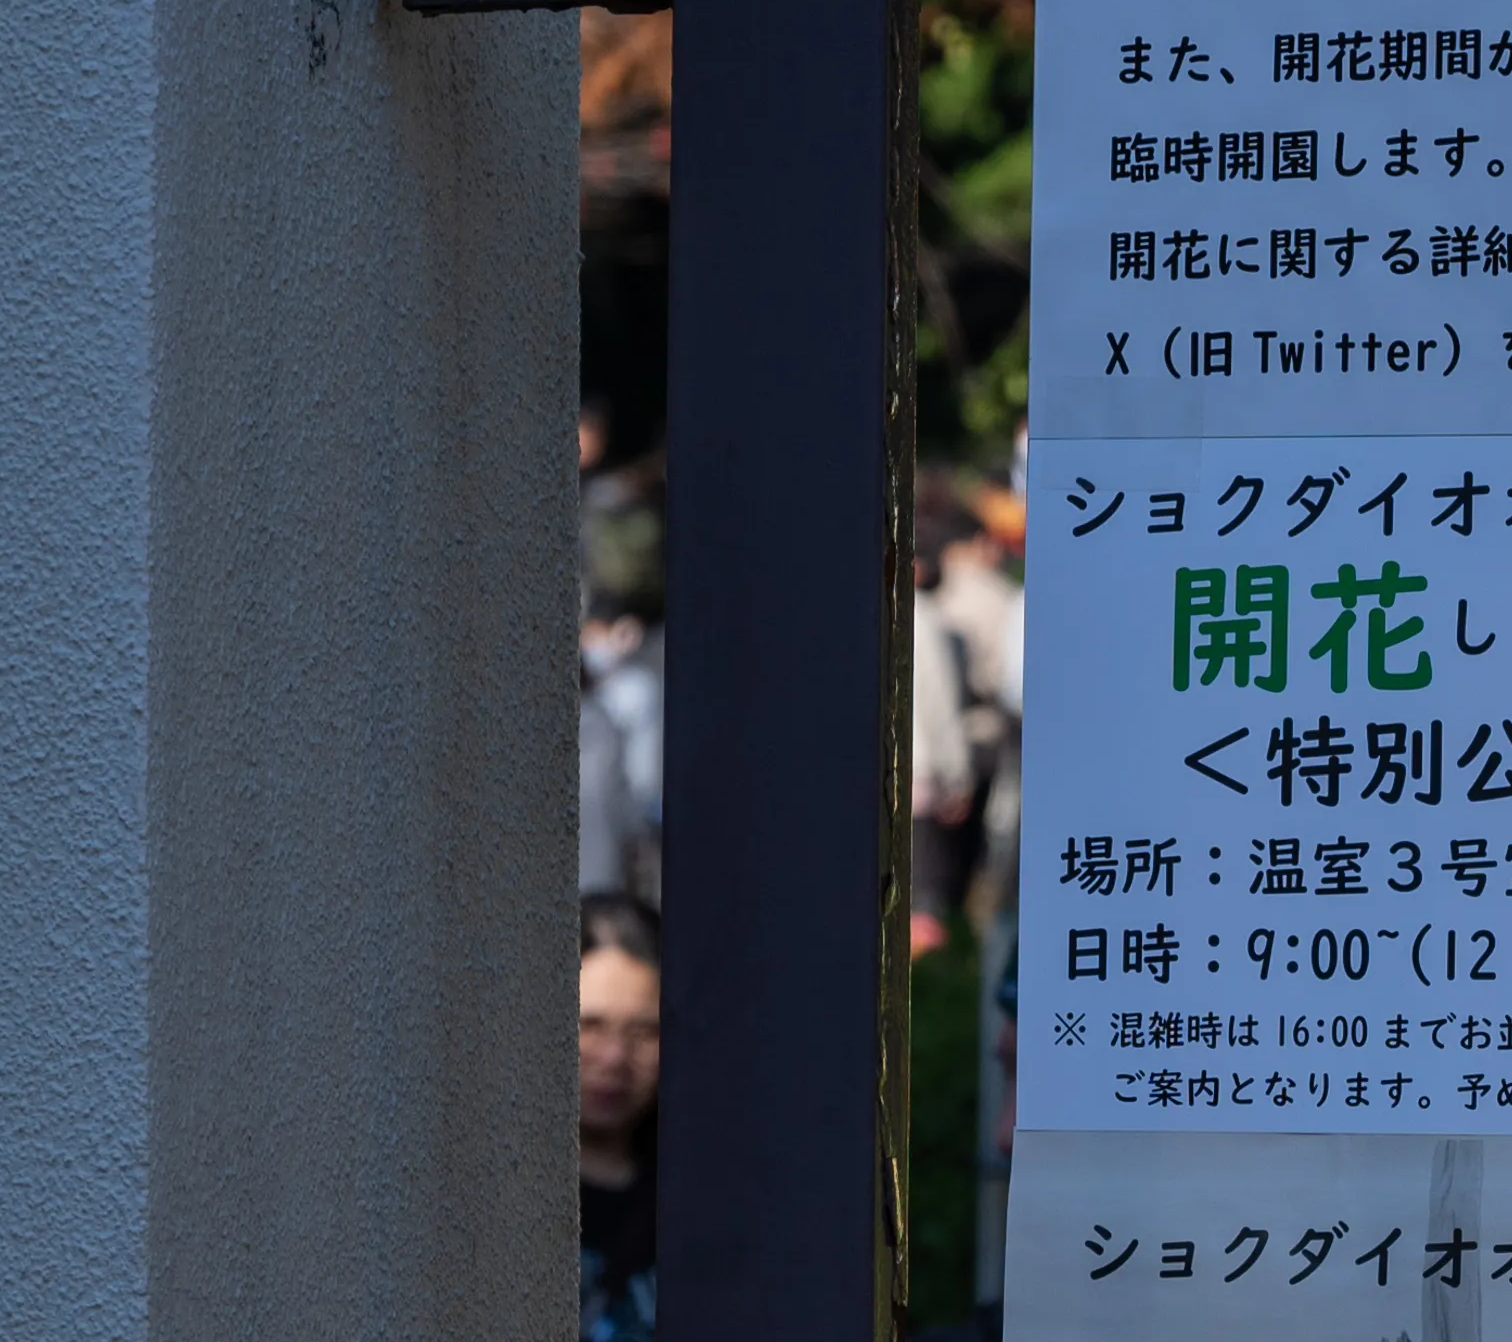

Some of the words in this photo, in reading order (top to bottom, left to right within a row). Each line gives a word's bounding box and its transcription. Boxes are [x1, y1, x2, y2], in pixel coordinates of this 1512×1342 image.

[1109, 126, 1506, 185] 臨時開園します。
